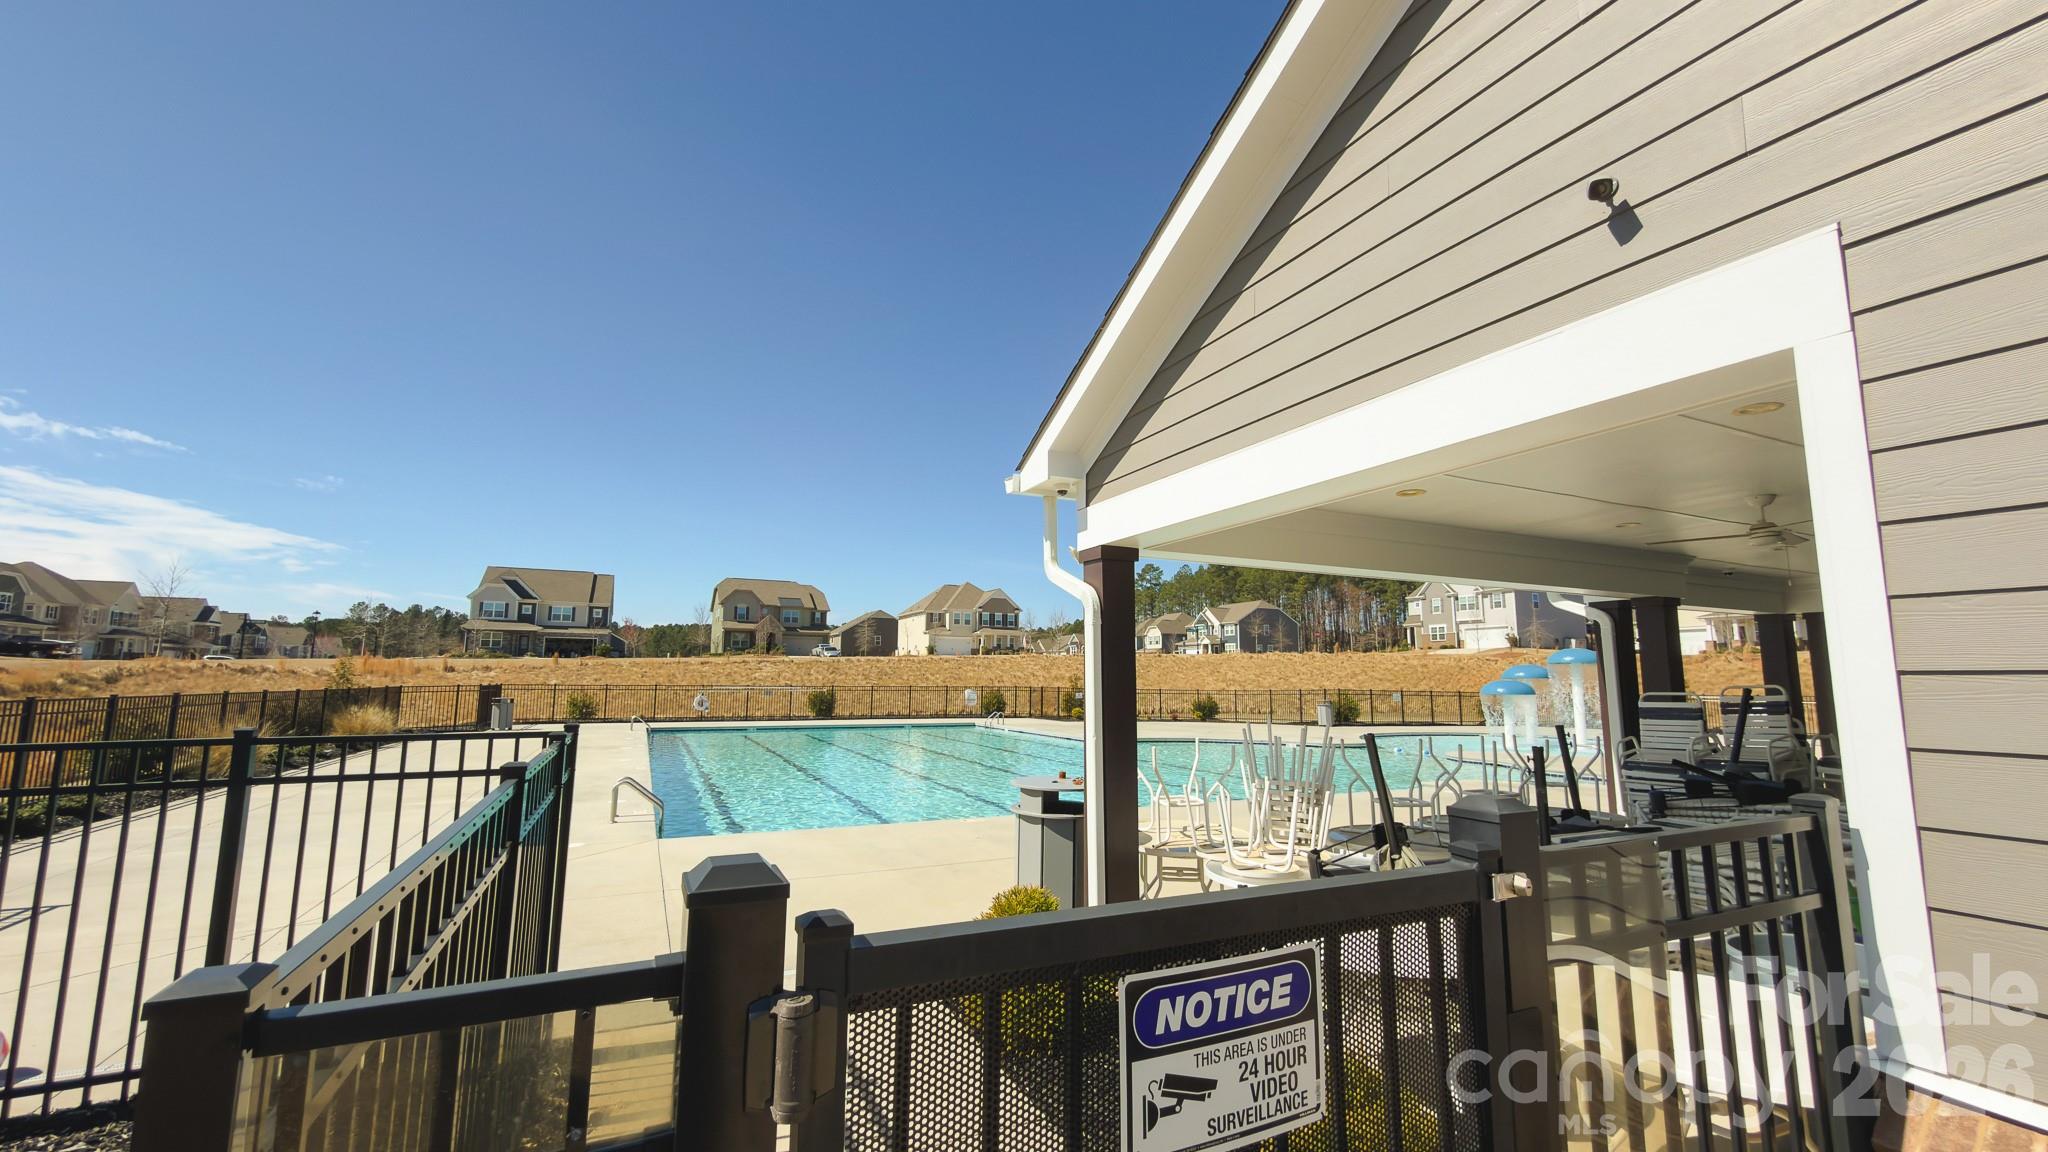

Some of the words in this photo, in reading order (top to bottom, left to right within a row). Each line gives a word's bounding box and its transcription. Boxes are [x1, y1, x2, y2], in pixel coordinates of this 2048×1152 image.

[1155, 973, 1293, 1035] NOTICE
[1194, 1048, 1221, 1068] THIS
[1224, 1040, 1254, 1062] AREA
[1257, 1037, 1268, 1053] IS
[1271, 1027, 1307, 1049] UNDER
[1238, 1058, 1259, 1082] 24
[1264, 1045, 1307, 1076] HOUR
[1250, 1070, 1298, 1103] VIDEO
[1207, 1090, 1309, 1136] SURVEILLANCE
